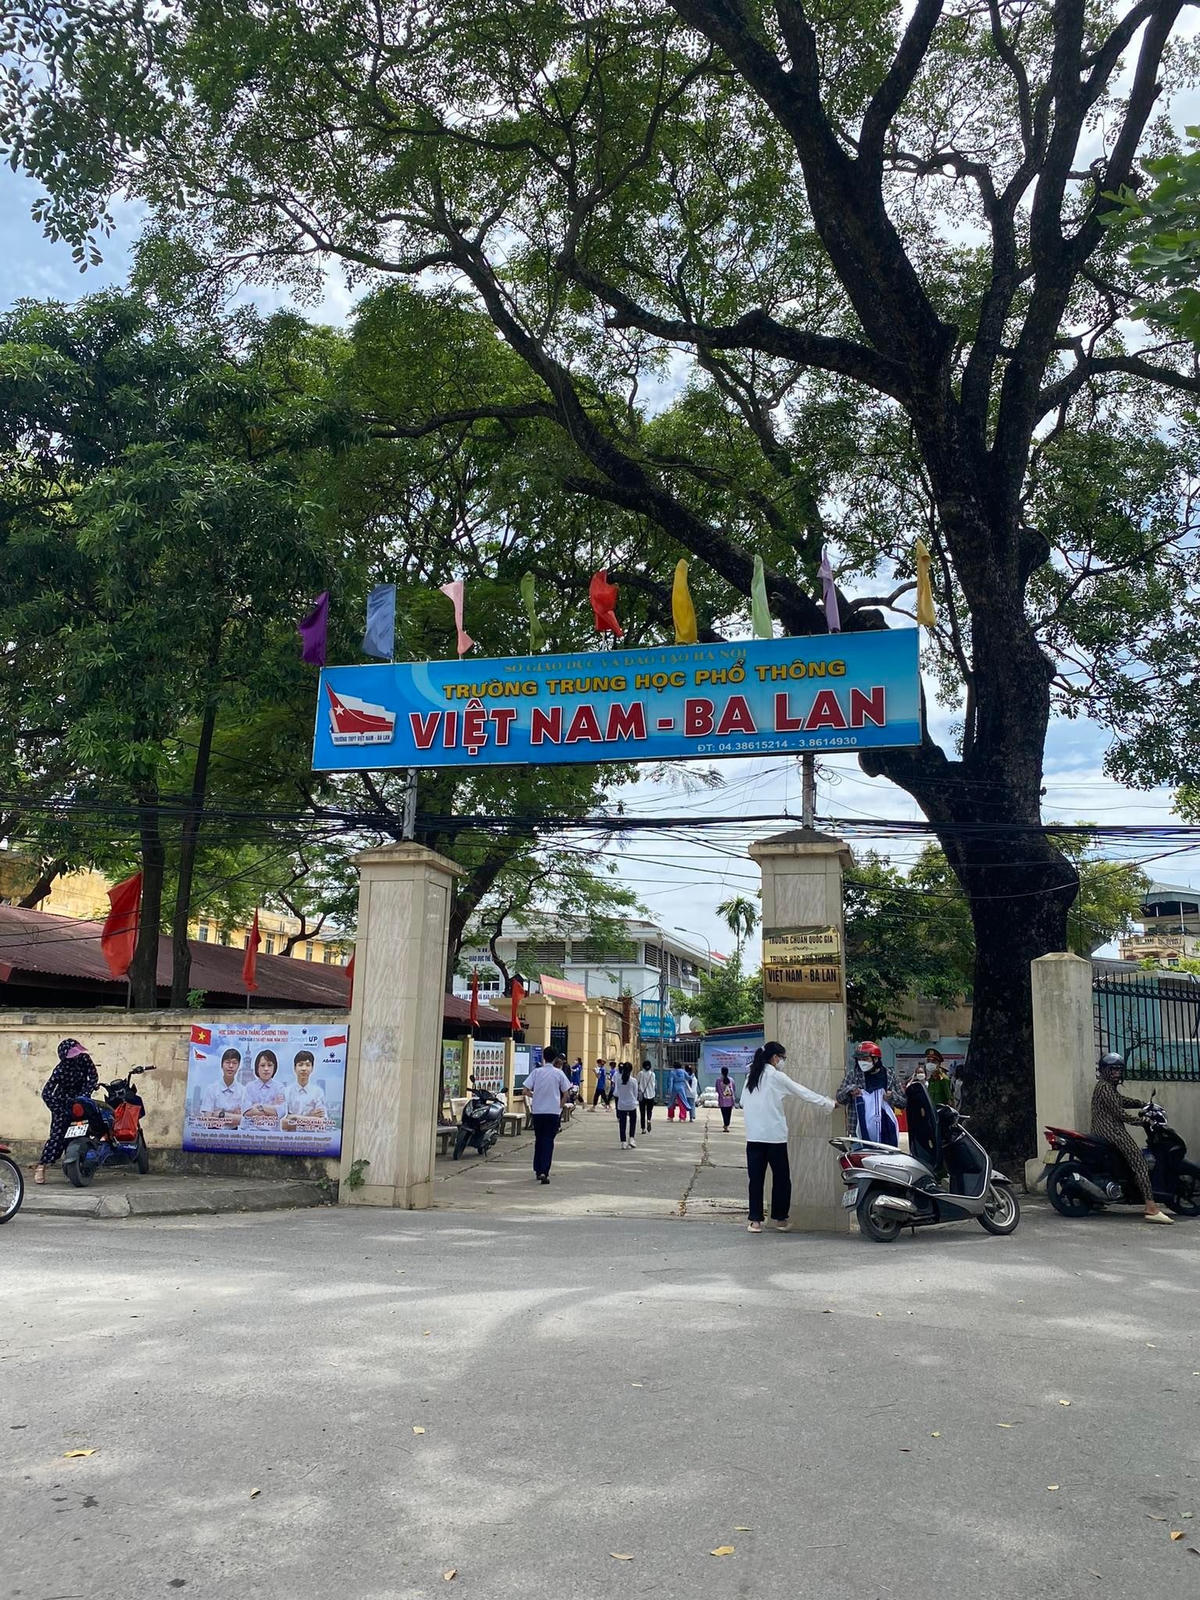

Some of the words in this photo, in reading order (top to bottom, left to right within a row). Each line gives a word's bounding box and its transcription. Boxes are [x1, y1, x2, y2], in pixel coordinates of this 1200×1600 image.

[443, 679, 538, 700] TRƯỜNG
[546, 675, 627, 695] TRUNG
[634, 670, 686, 694] HỌC
[694, 657, 746, 685] PHỔ
[755, 659, 847, 681] THÔNG
[408, 697, 517, 756] VIỆT
[529, 701, 647, 746] NAM
[683, 693, 758, 738] BA
[774, 685, 887, 732] LAN
[697, 744, 716, 753] ĐT:
[718, 739, 788, 752] 04.38615214
[799, 736, 858, 748] 3.8614930
[767, 966, 784, 986] VIỆT
[785, 969, 803, 983] NAM
[809, 969, 820, 983] BA
[822, 968, 837, 983] LAN
